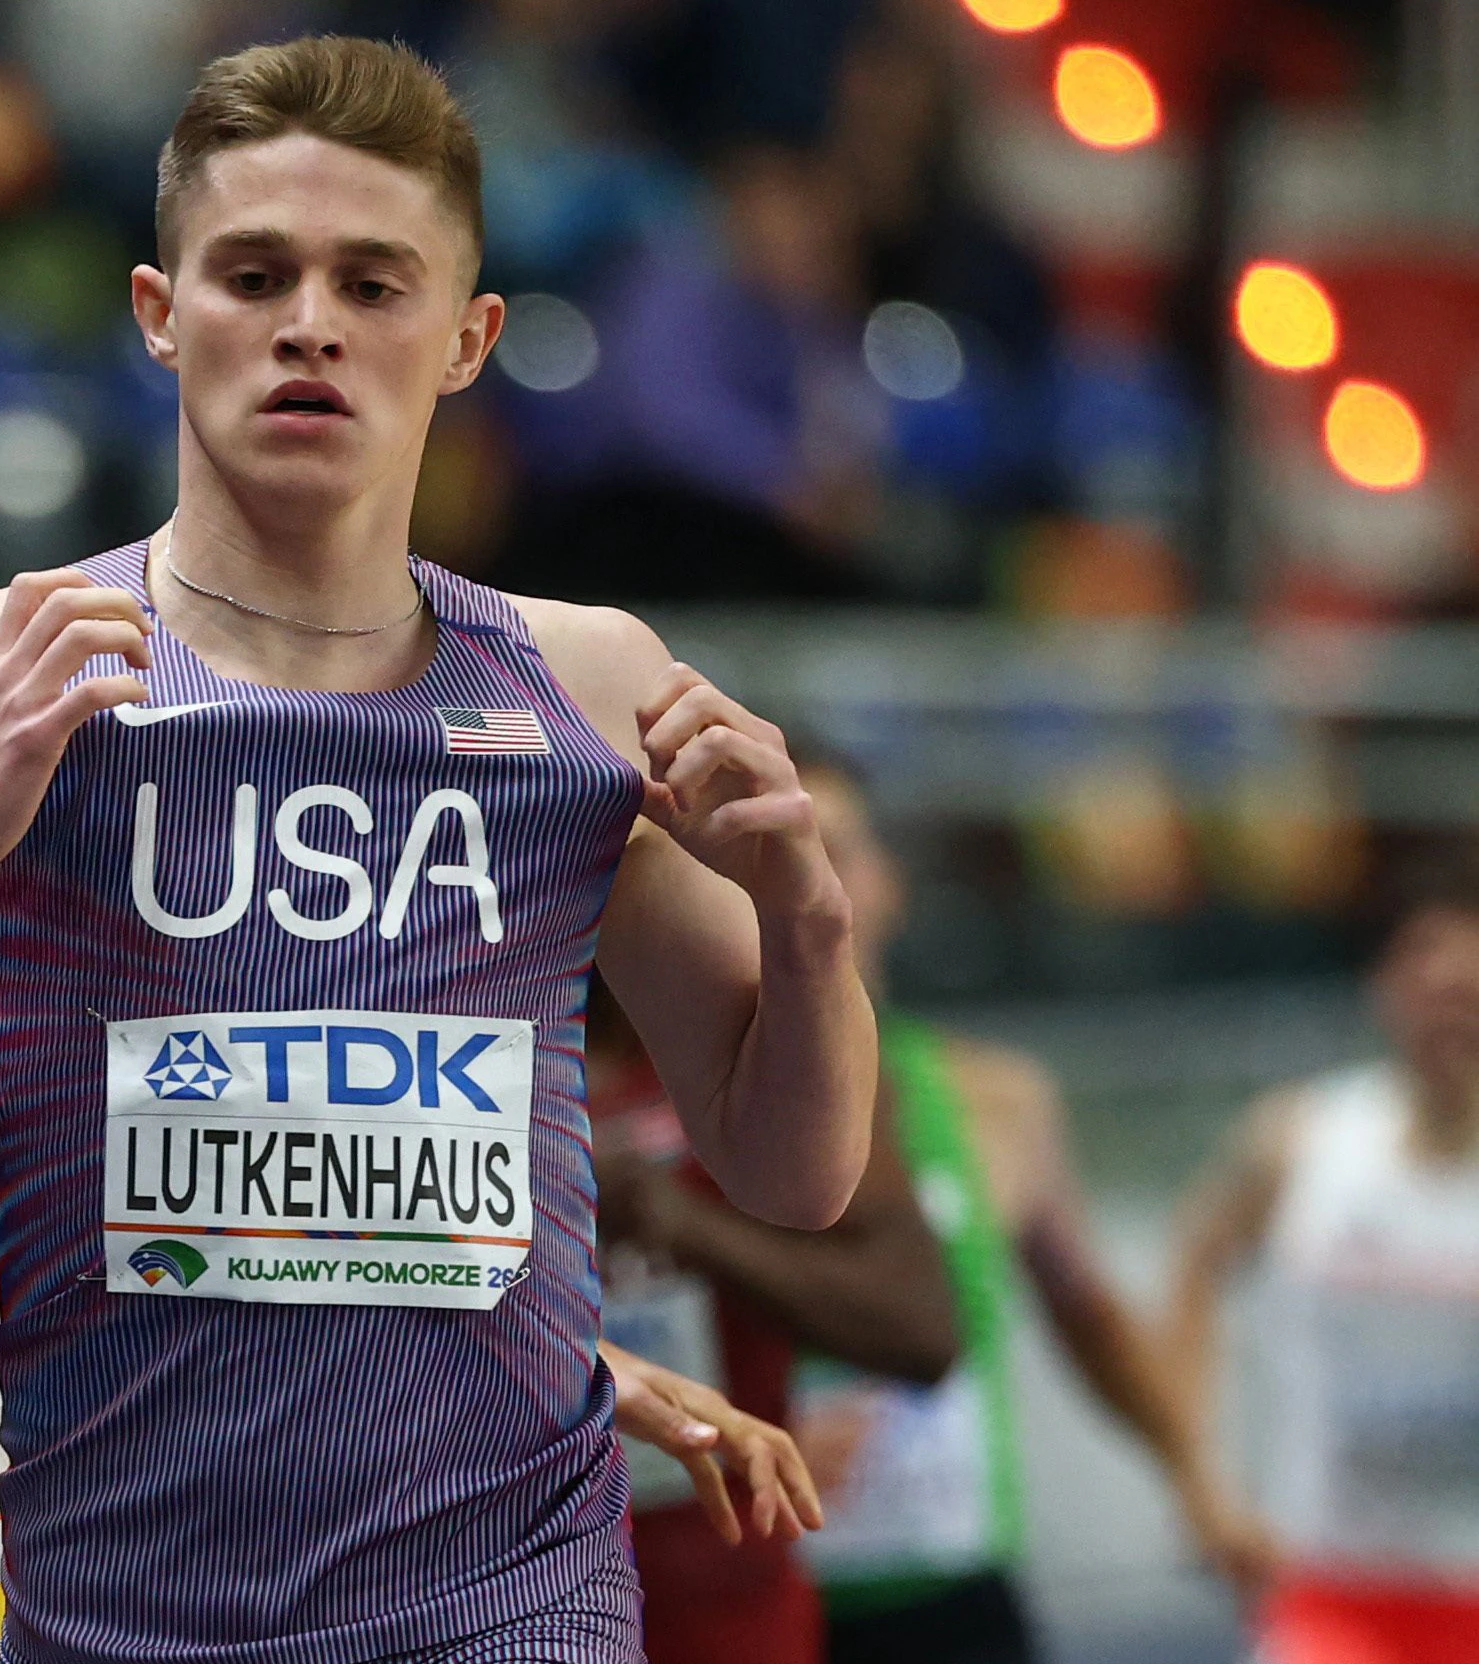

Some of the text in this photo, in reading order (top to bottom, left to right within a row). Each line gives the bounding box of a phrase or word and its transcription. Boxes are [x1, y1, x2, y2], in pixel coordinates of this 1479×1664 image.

[131, 782, 504, 944] USA
[228, 1025, 502, 1114] TDK
[126, 1127, 515, 1227] LUTKENHAUS
[227, 1257, 342, 1284] KUJAWY
[346, 1261, 481, 1288] POMORZE
